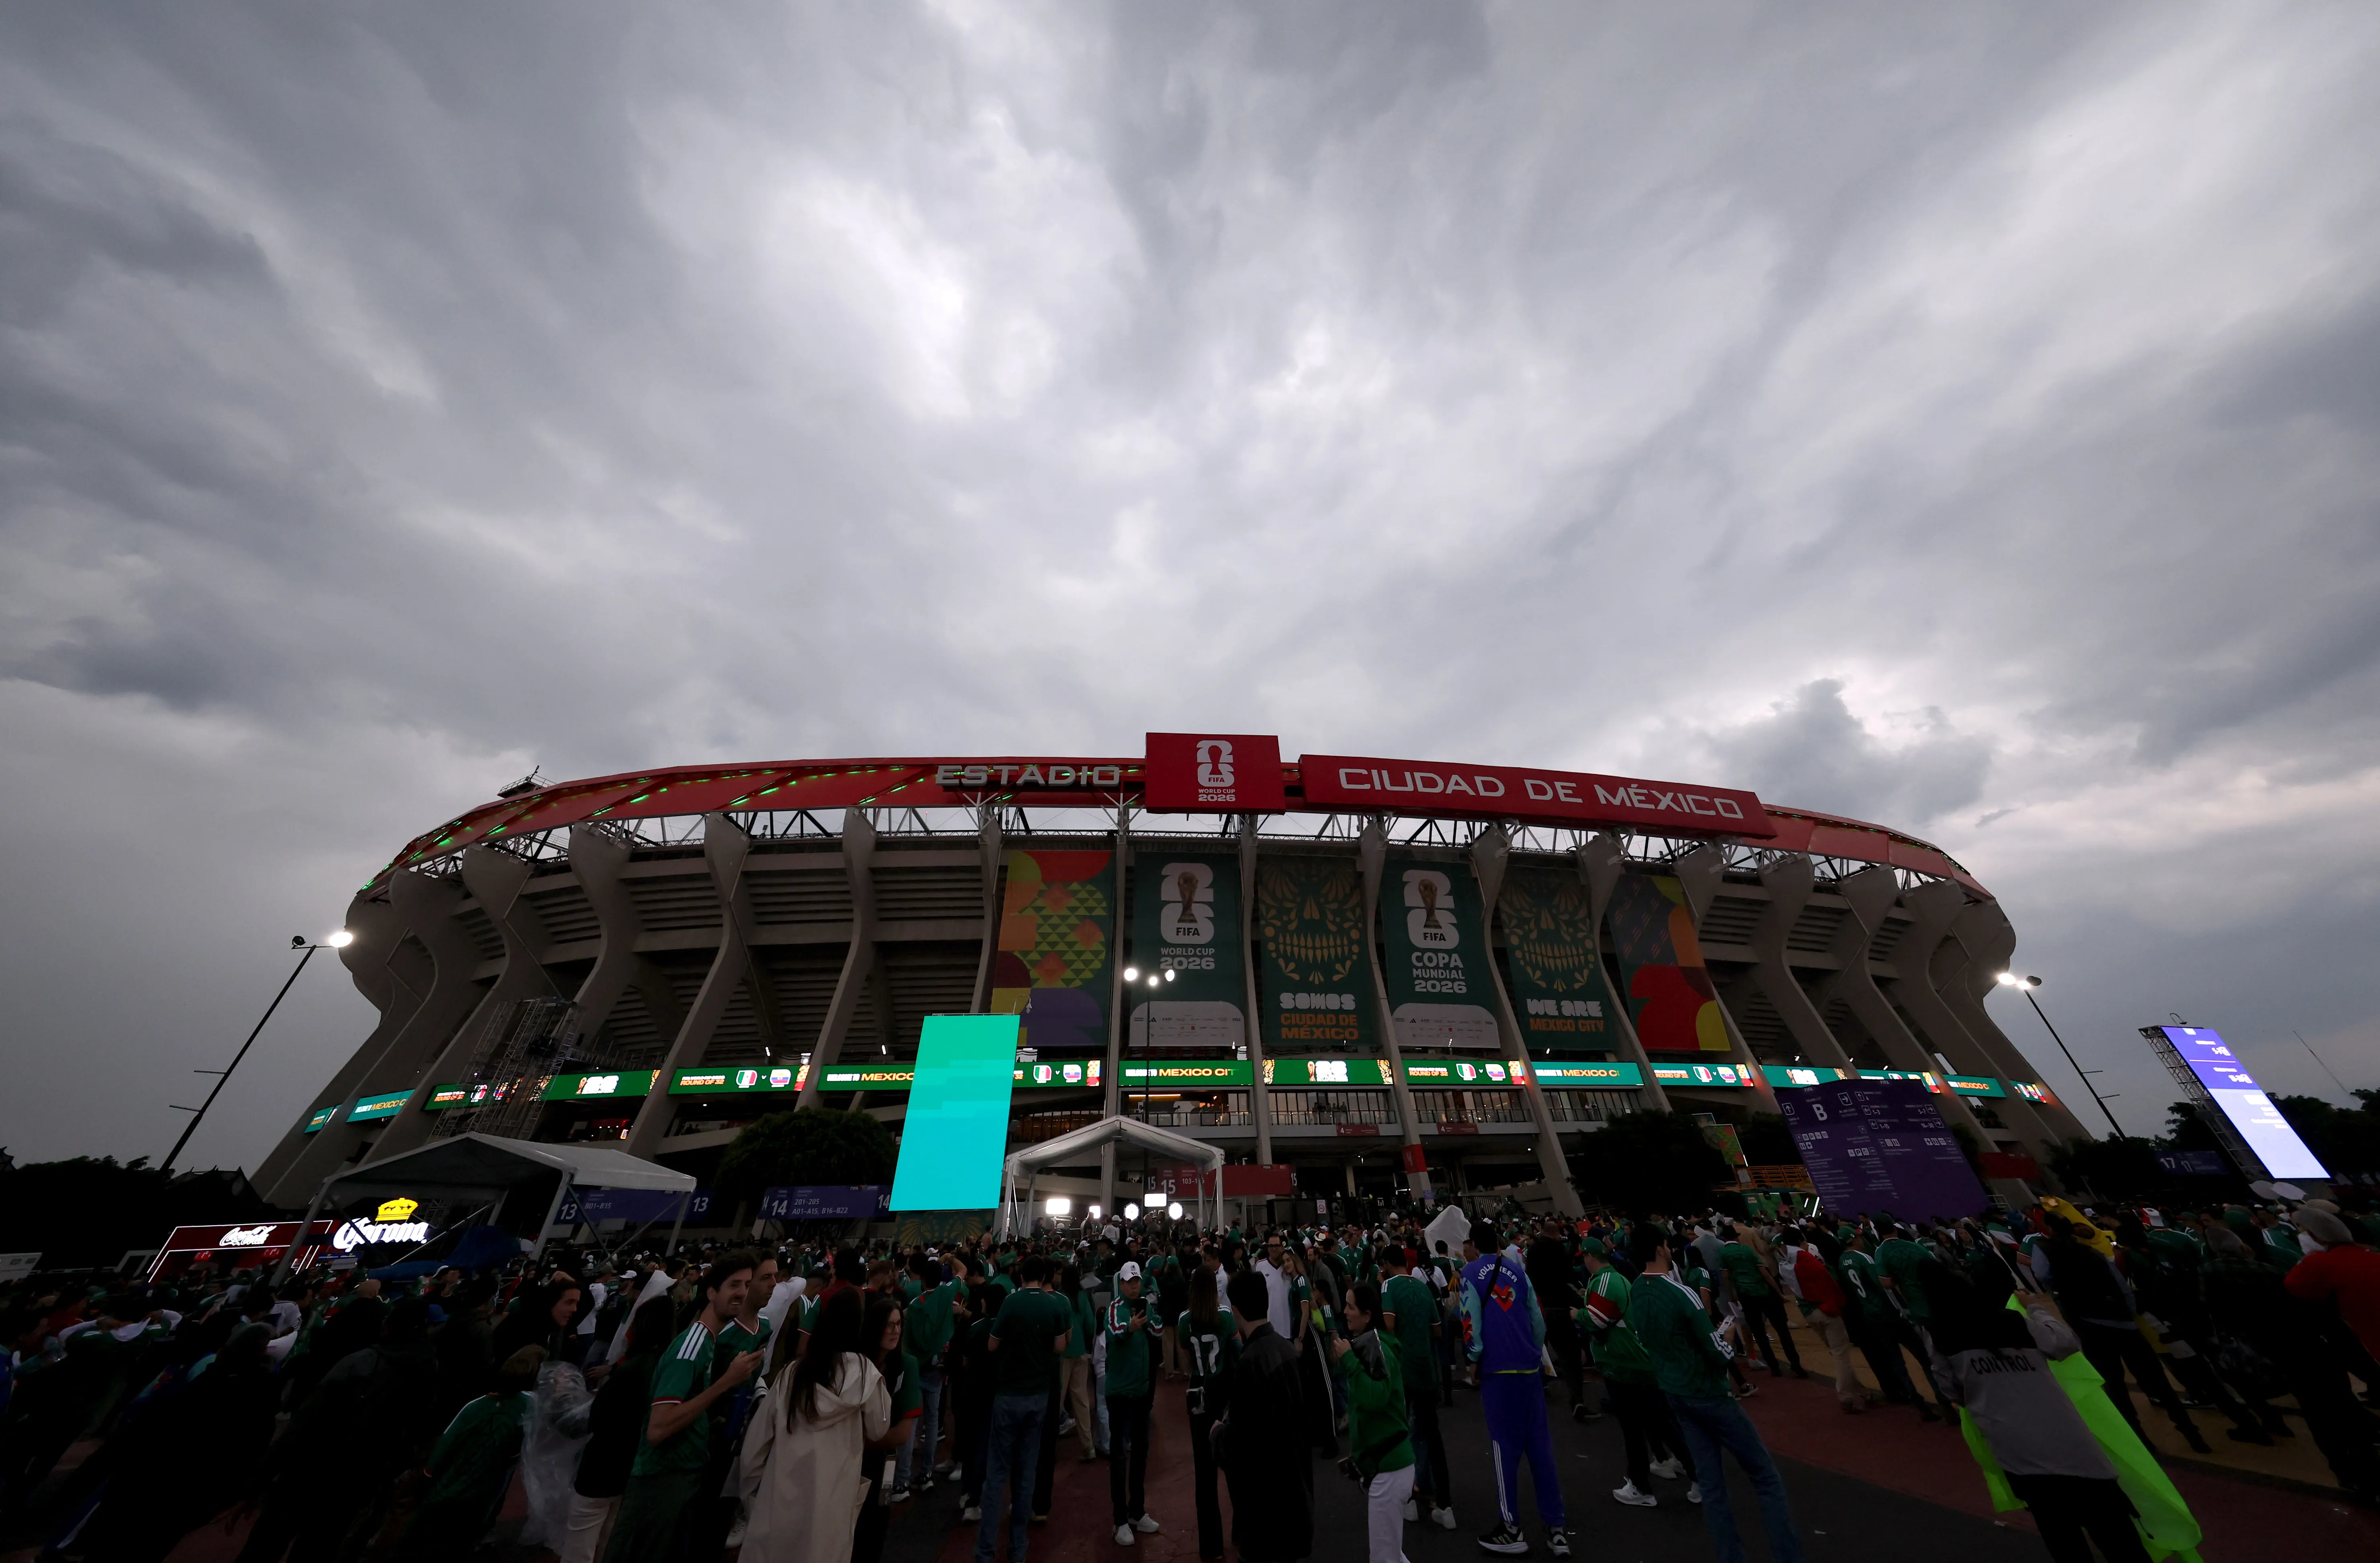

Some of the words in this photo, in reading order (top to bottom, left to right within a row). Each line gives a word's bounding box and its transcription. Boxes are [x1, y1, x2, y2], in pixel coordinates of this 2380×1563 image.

[935, 765, 1120, 786] ESTADIO
[1339, 768, 1505, 797] CIUDAD
[1524, 779, 1583, 803] DE
[1594, 784, 1743, 819] MÉXICO
[1176, 928, 1200, 936] FIFA
[1423, 933, 1446, 941] FIFA
[1160, 957, 1215, 970] 2026
[1411, 952, 1463, 968] COPA
[1413, 969, 1465, 979] MUNDIAL
[1414, 980, 1467, 993] 2026
[1280, 992, 1355, 1010] SOMOS
[1526, 999, 1559, 1016] WE
[1561, 1001, 1603, 1017] ARE
[1281, 1014, 1337, 1026] CIUDAD
[1339, 1014, 1357, 1026] DE
[1530, 1018, 1575, 1032] MEXICO
[1579, 1019, 1604, 1032] CITY
[1281, 1026, 1358, 1040] MÉXICO
[1159, 1068, 1213, 1076] MEXICO
[372, 1100, 399, 1110] MEXICO
[1812, 1104, 1828, 1121] B
[2160, 1157, 2175, 1168] 17
[1148, 1176, 1156, 1190] 15
[1161, 1179, 1176, 1194] 15
[1291, 1173, 1297, 1186] 15
[693, 1197, 709, 1212] 13
[772, 1200, 788, 1216] 14
[878, 1194, 891, 1209] 14
[560, 1203, 577, 1220] 13
[1478, 1263, 1518, 1283] VOLUTEER
[1848, 1269, 1866, 1298] 9
[1190, 1334, 1220, 1376] 17
